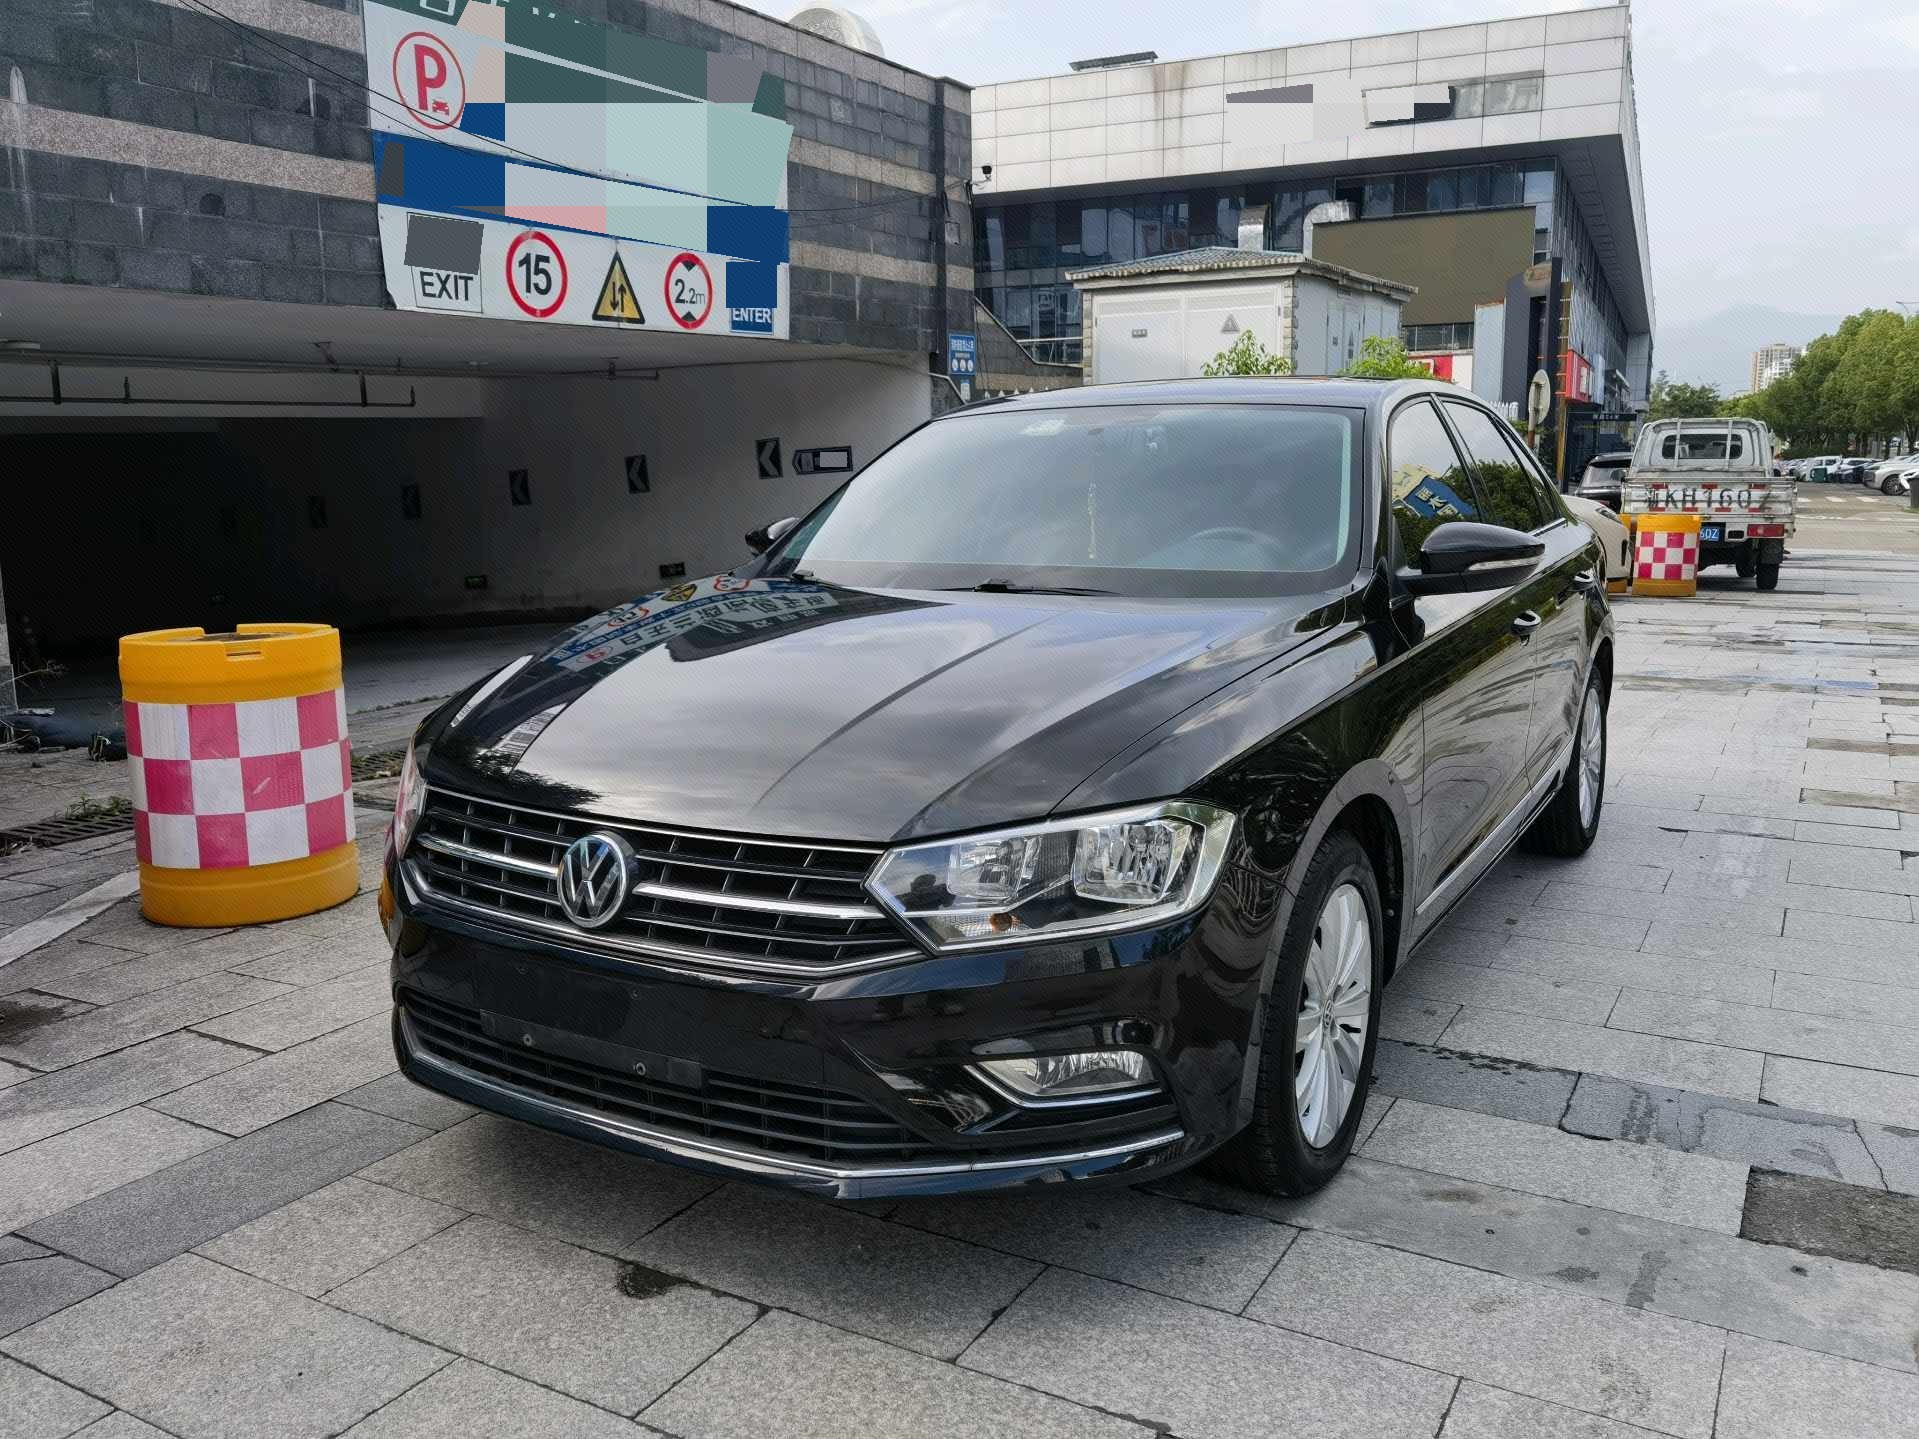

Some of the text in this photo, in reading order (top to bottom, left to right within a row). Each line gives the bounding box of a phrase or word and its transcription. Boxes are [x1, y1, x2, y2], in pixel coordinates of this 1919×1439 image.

[414, 44, 447, 111] P
[419, 271, 474, 301] EXIT
[518, 253, 552, 296] 15
[674, 278, 706, 305] 2.2m
[732, 308, 771, 323] ENTER
